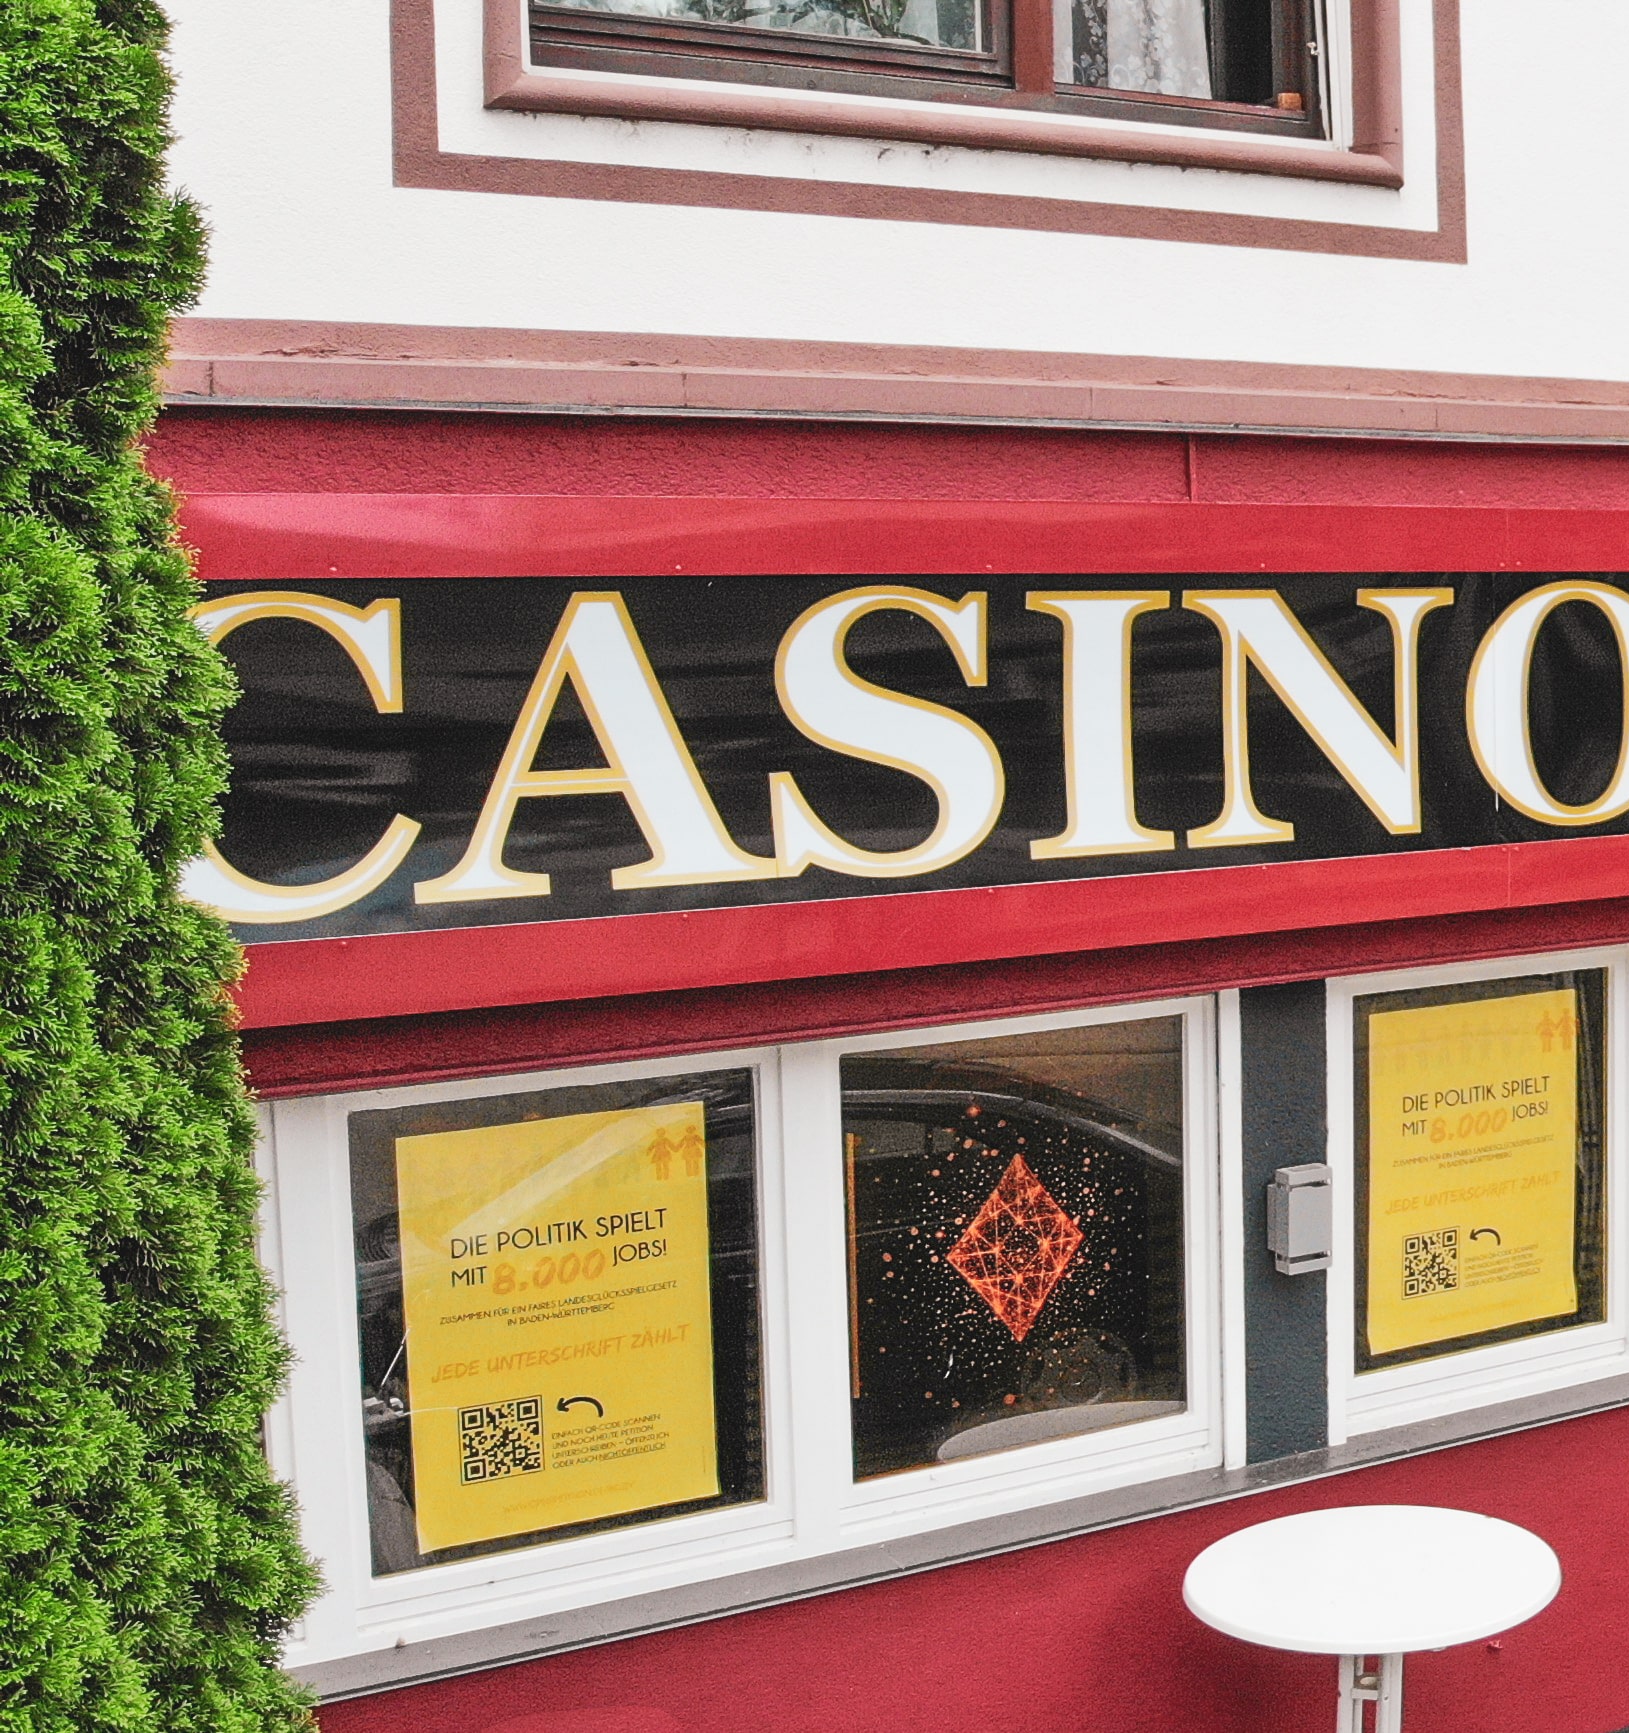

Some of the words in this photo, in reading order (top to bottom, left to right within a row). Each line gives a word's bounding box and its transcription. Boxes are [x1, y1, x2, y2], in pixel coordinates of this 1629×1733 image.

[1402, 1093, 1429, 1114] DIE
[1434, 1084, 1497, 1109] POLITIK
[1501, 1075, 1550, 1098] SPIELT
[1402, 1119, 1428, 1137] MIT
[1430, 1107, 1508, 1144] 8.000
[1512, 1101, 1549, 1122] JOBS!
[1385, 1196, 1419, 1215] JEDE
[1424, 1180, 1516, 1206] UNTERSCHRIFT
[451, 1234, 488, 1259] DIE
[497, 1219, 587, 1252] POLITIK
[595, 1208, 667, 1238] SPIELT
[451, 1266, 488, 1288] MIT
[492, 1248, 606, 1295] 8.000
[612, 1239, 668, 1267] JOBS!
[440, 1310, 492, 1325] ZUSAMMEN
[493, 1305, 509, 1317] FÜR
[511, 1304, 527, 1315] EIN
[528, 1301, 556, 1312] FAIRES
[507, 1317, 518, 1327] IN
[431, 1360, 480, 1384] JEDE
[487, 1335, 627, 1373] UNTERSCHRIFT
[630, 1323, 691, 1350] ZÄHLT
